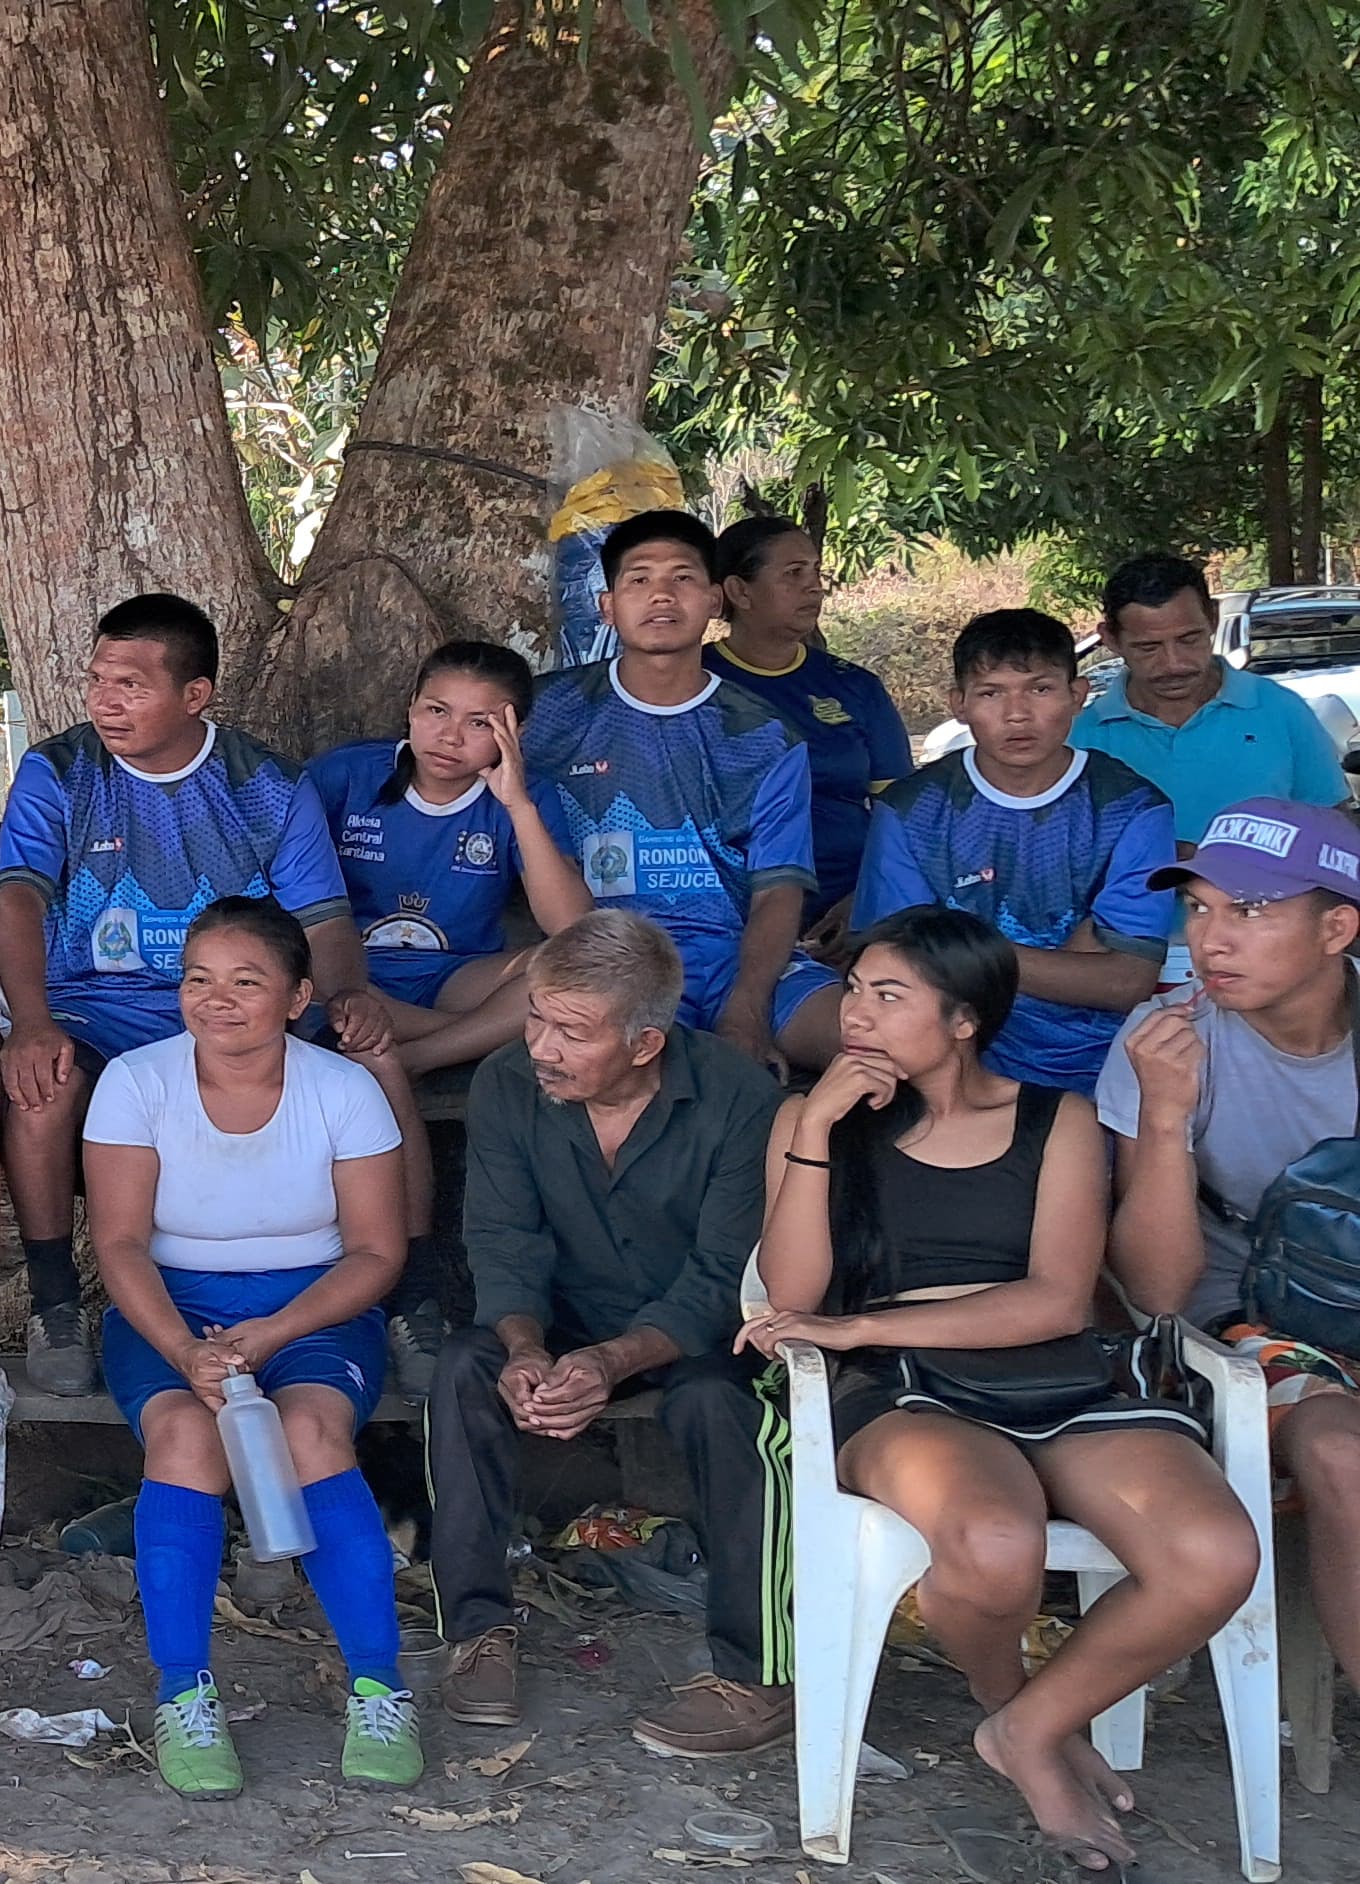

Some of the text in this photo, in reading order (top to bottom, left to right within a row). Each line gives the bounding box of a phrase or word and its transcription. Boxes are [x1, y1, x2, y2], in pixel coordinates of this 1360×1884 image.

[347, 814, 381, 828] Aldeia
[342, 830, 384, 845] Central
[639, 844, 710, 865] RONDÔN
[647, 872, 724, 889] SEJUCEL
[152, 953, 184, 969] SE
